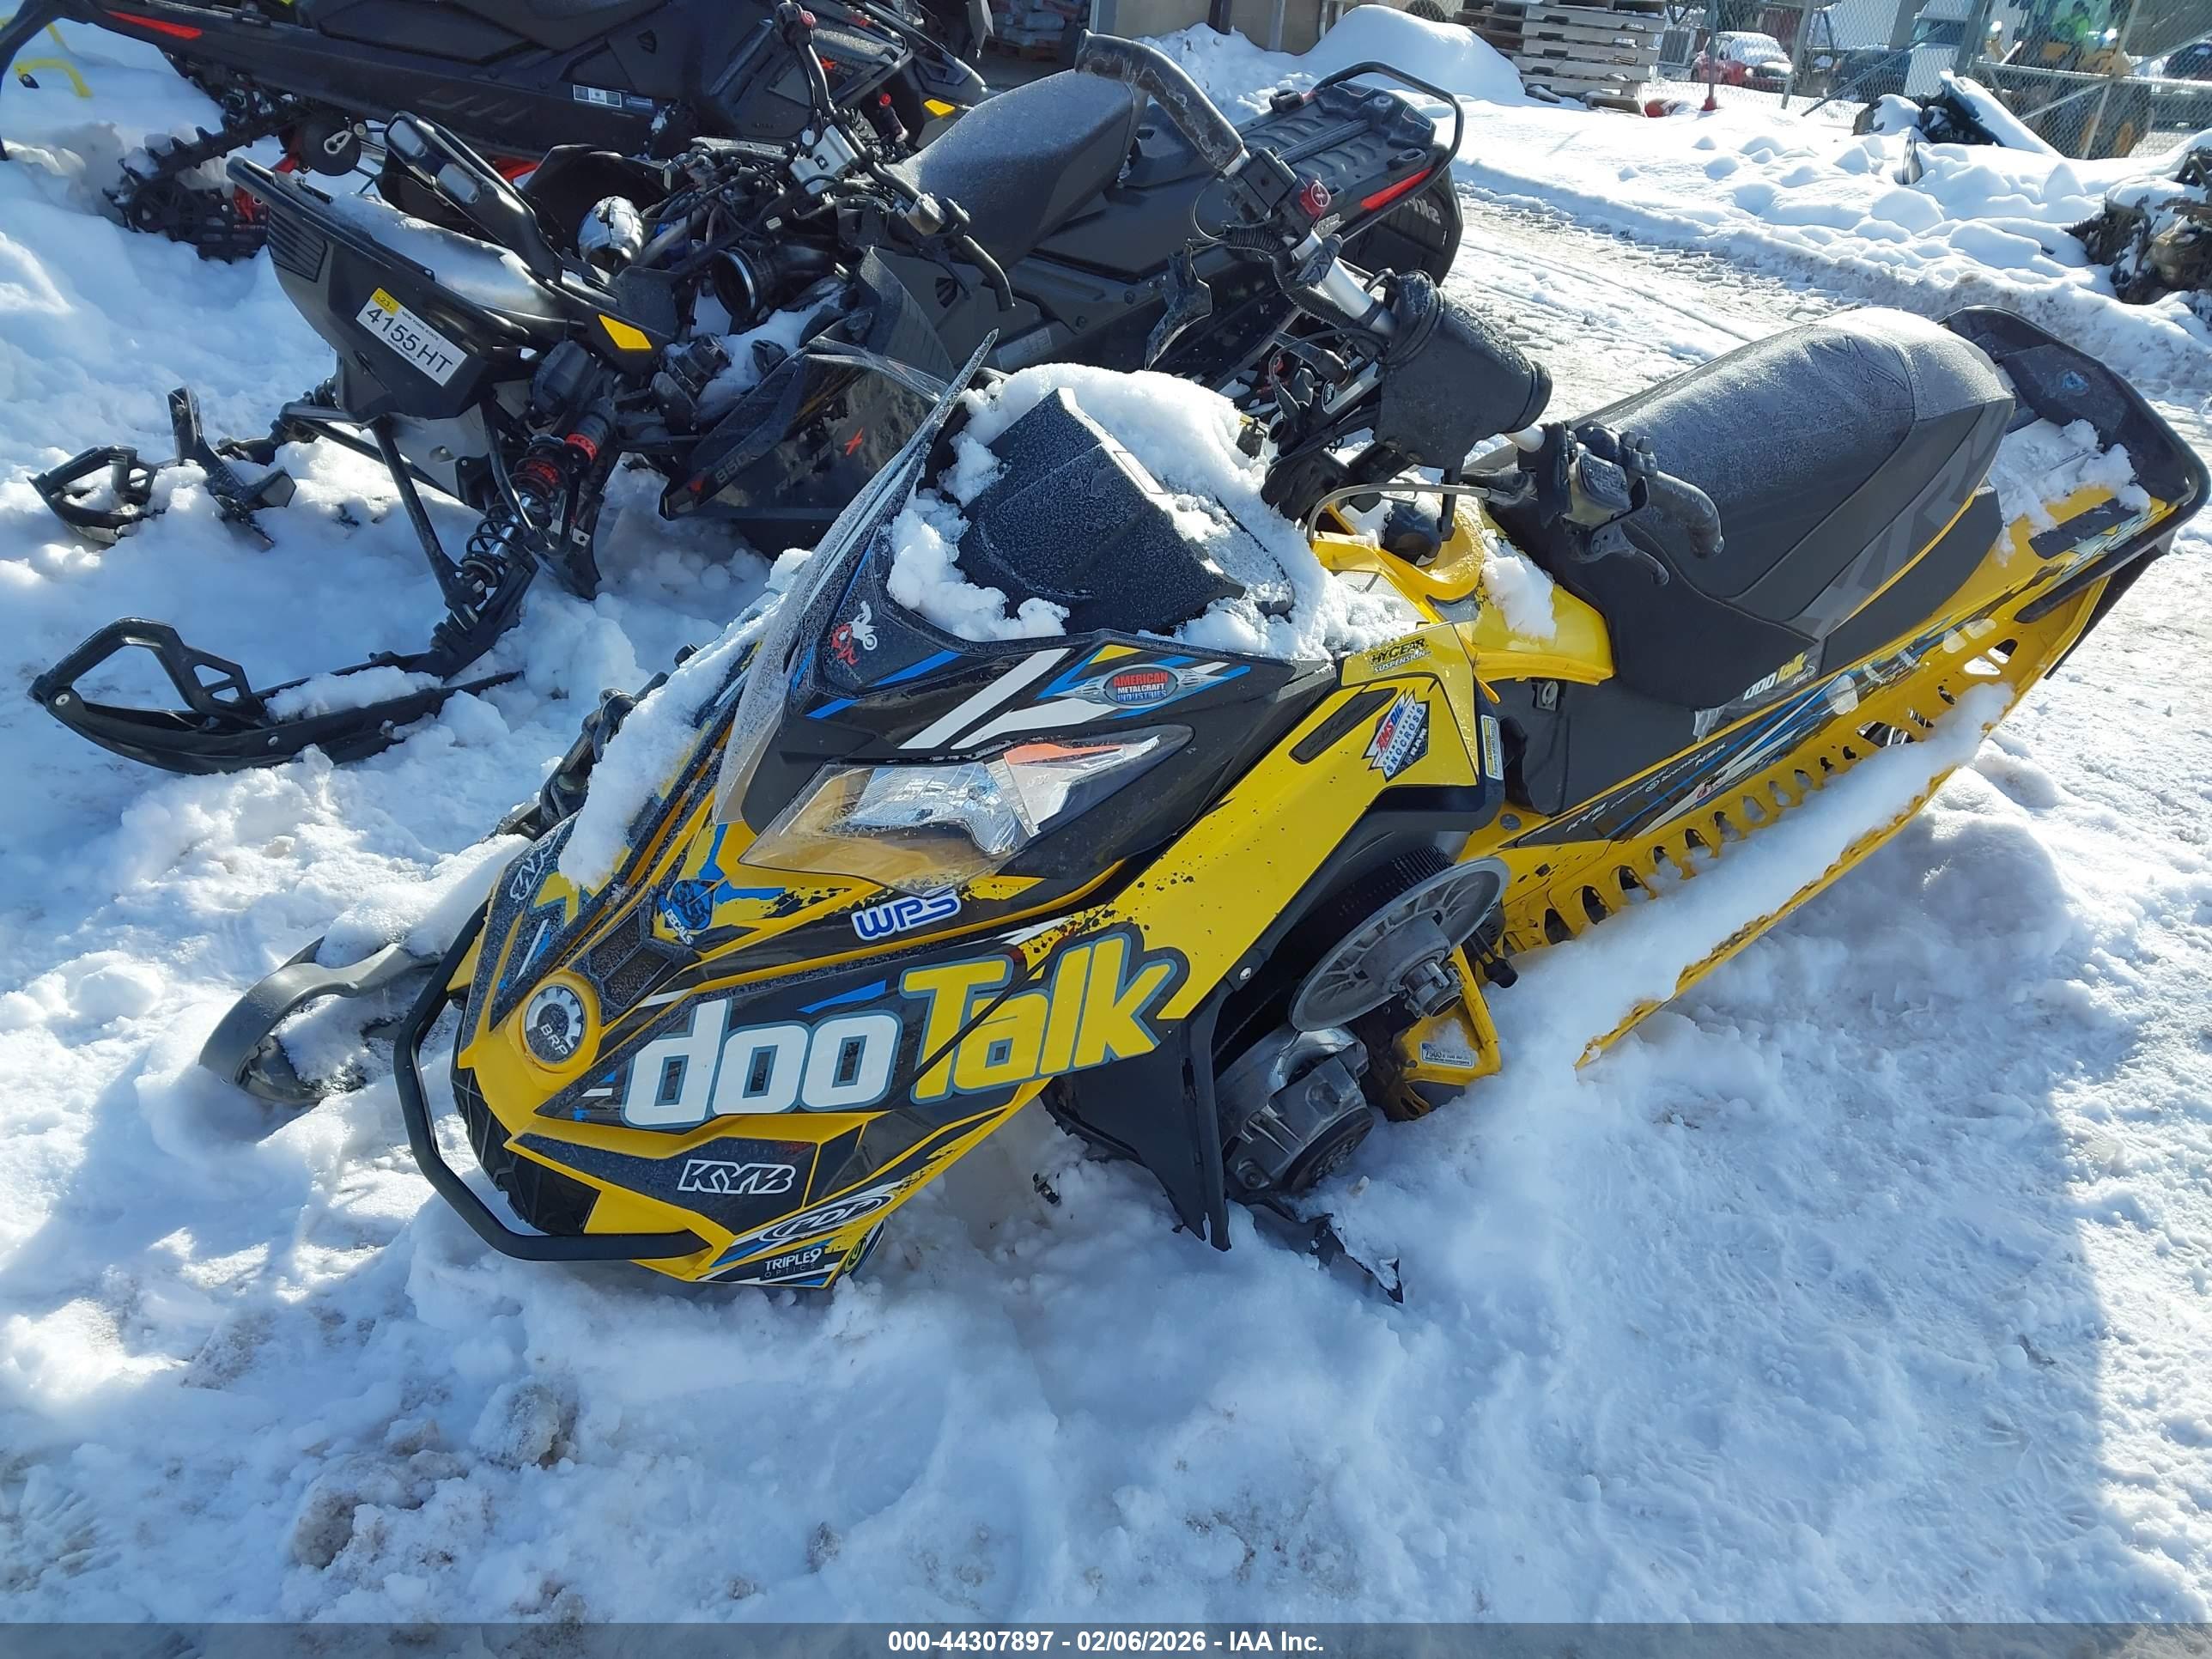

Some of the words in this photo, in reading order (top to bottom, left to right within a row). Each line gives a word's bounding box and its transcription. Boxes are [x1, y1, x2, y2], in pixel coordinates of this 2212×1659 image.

[1374, 650, 1427, 674] SUSPENSION
[1113, 672, 1169, 688] AMERICAN
[1117, 683, 1165, 695] METALCRAFT
[1116, 690, 1167, 702] INDUSTRIES
[1376, 700, 1405, 754] AMSOIL
[1382, 705, 1417, 766] CHAMPIONSHIP
[1386, 707, 1425, 774] SNOCROSS
[1409, 727, 1428, 757] RAM
[664, 908, 694, 945] DECALS
[853, 886, 961, 940] WPS
[539, 1023, 569, 1056] BRP
[677, 1159, 797, 1194] KYB
[764, 1248, 823, 1272] TRIPLE9
[764, 1262, 817, 1279] OPTICS
